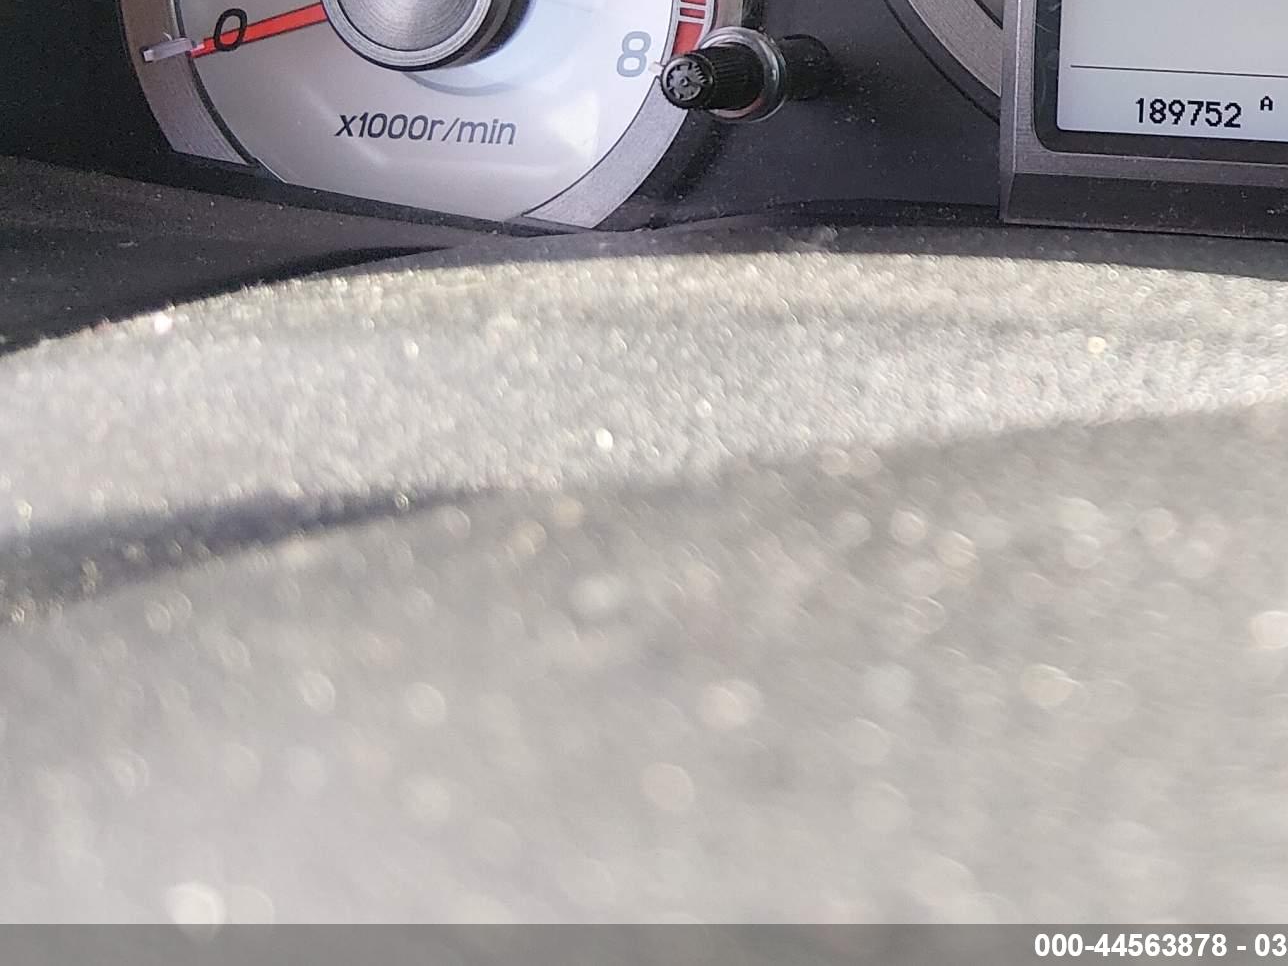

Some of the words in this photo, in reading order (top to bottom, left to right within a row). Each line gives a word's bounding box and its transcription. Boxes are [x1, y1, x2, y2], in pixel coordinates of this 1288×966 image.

[214, 8, 248, 52] 0
[617, 31, 651, 77] 8
[1136, 98, 1241, 128] 189752
[1260, 96, 1273, 111] A
